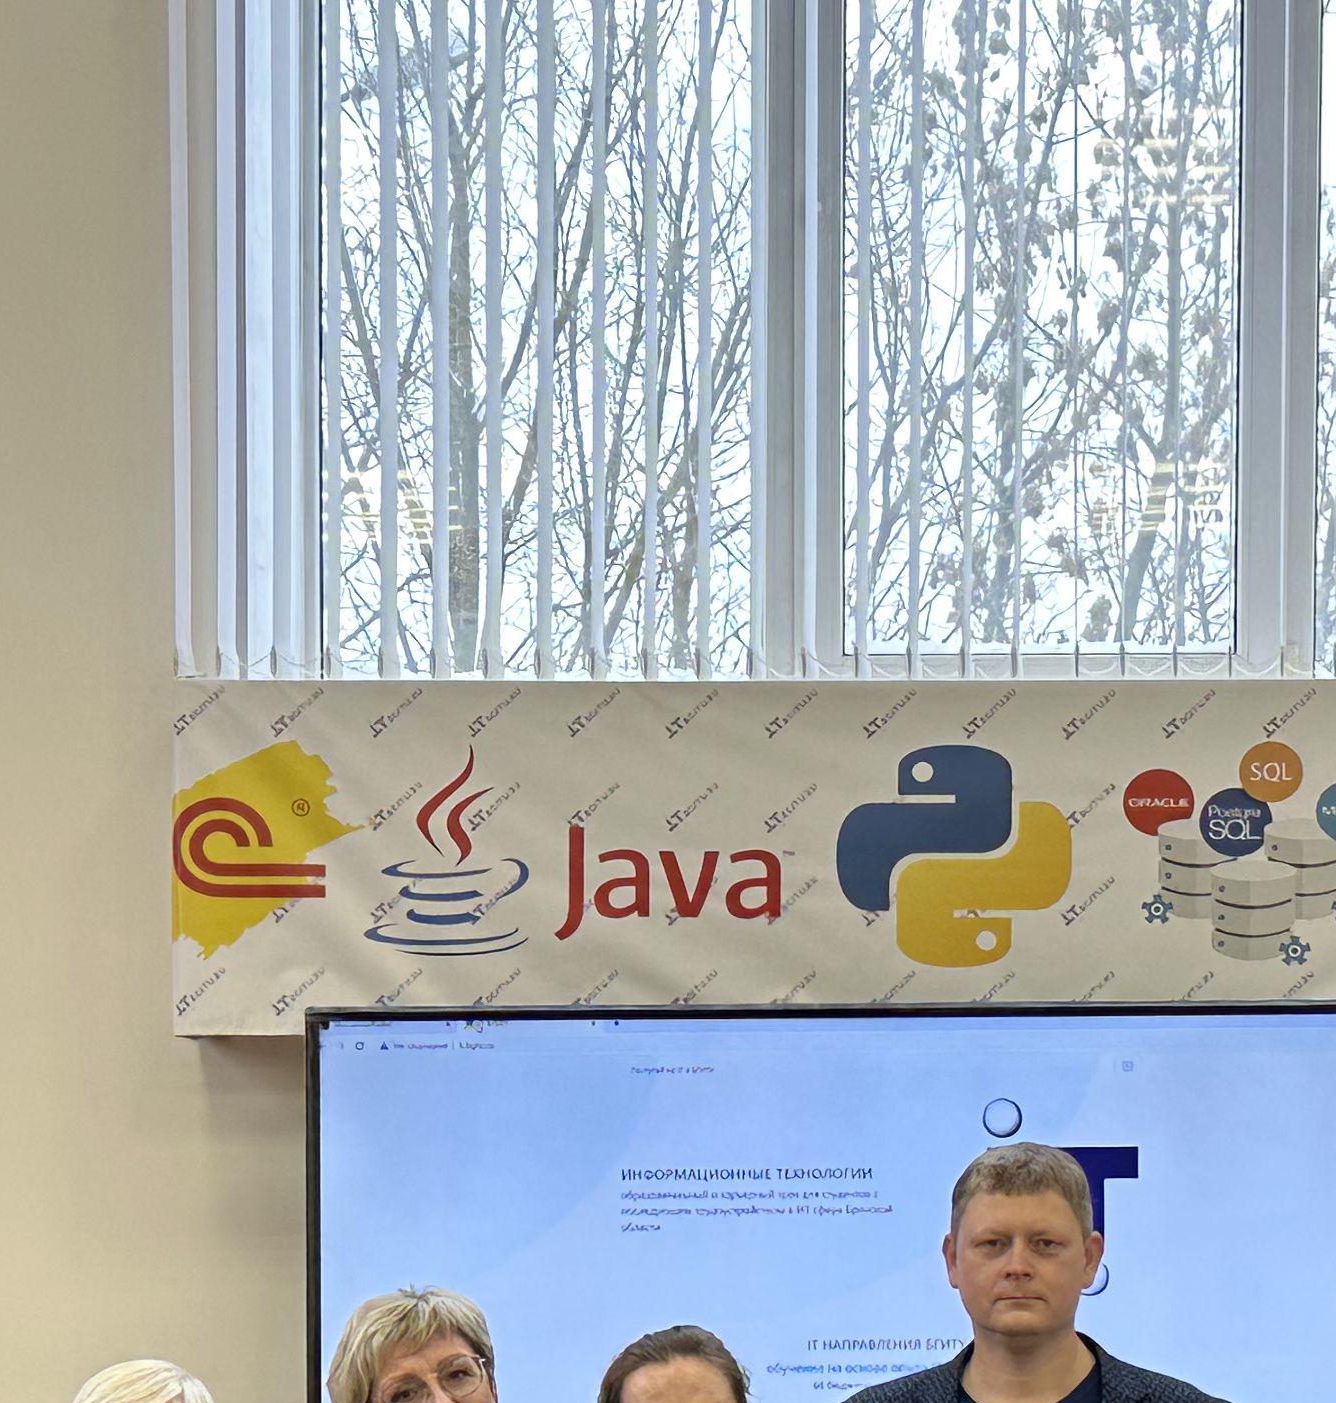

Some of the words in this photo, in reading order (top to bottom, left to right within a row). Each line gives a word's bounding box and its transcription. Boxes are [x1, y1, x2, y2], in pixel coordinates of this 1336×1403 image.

[1250, 762, 1293, 782] SQL
[1127, 797, 1190, 808] ORACLE
[1207, 819, 1262, 841] SQL
[554, 824, 782, 941] Java
[621, 1168, 771, 1182] ИНФОРМАЦИОННЫЕ
[776, 1168, 873, 1181] ТЕХНОЛОГИИ
[823, 1339, 922, 1351] НАПРАВЛЕНИЯ
